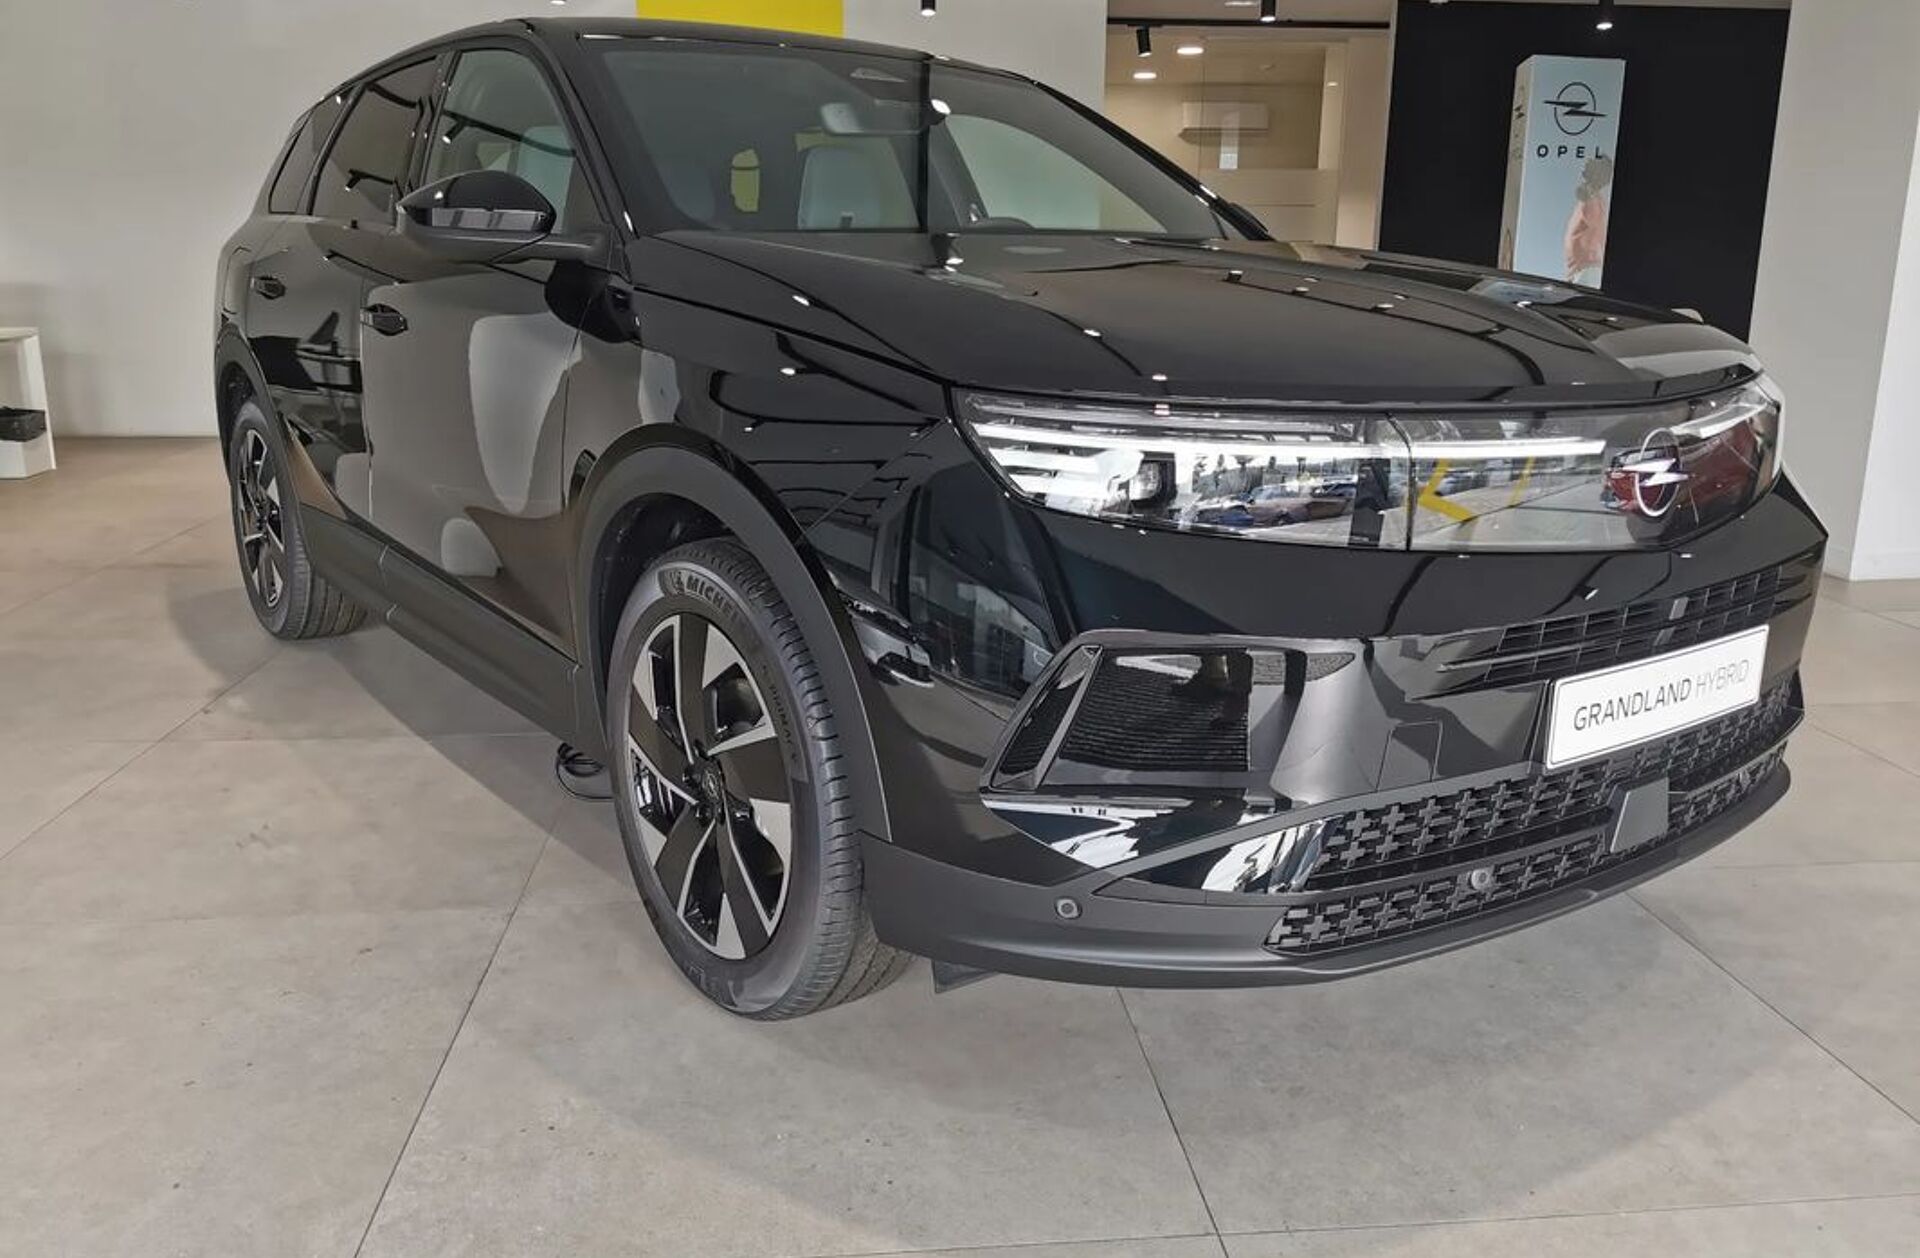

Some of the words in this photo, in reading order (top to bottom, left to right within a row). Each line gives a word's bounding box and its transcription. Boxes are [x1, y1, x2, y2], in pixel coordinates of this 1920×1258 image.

[1536, 144, 1604, 159] OPEL
[1573, 678, 1692, 731] GRANDLAND
[1696, 658, 1750, 697] HYBRID
